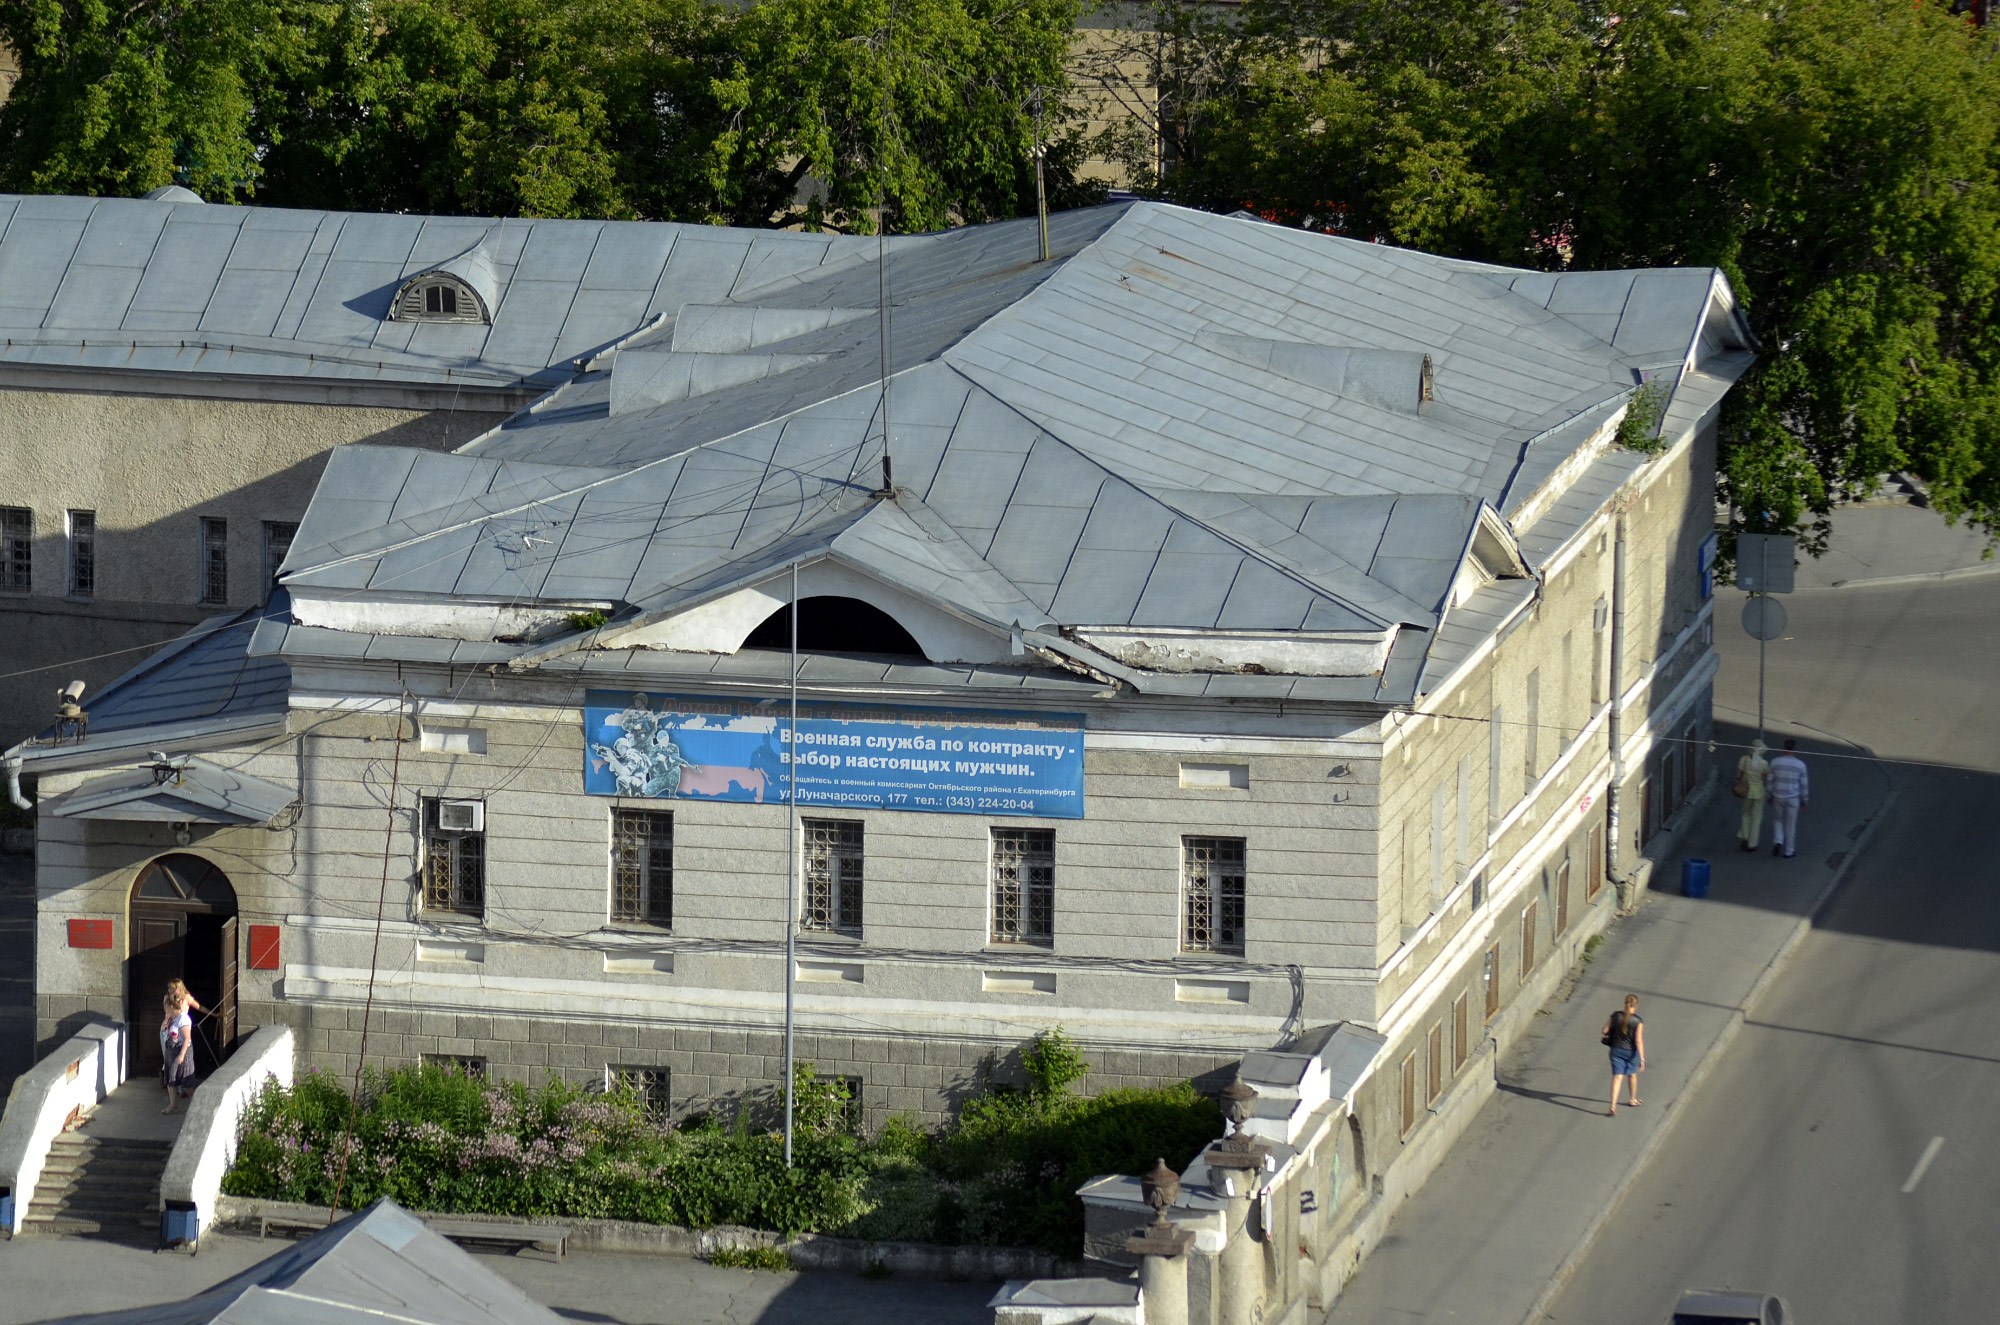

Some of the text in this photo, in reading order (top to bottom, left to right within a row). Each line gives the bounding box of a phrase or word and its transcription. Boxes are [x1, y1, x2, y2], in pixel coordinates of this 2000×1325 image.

[661, 697, 732, 717] Армия
[831, 710, 896, 726] армия
[780, 728, 862, 747] Военная
[866, 735, 936, 752] служба
[941, 740, 964, 752] по
[968, 741, 1066, 760] контракту
[780, 751, 1035, 777] выбор настоящих мужчин.
[779, 775, 832, 786] Обащайтесь
[841, 779, 875, 787] военный
[877, 780, 927, 790] комиссариат
[928, 783, 982, 793] Октябрьского
[984, 786, 1012, 794] района
[1013, 788, 1076, 798] г.Екатеринбурга
[888, 794, 908, 804] 177
[914, 796, 942, 806] тел.:
[946, 796, 975, 809] (343)
[978, 798, 1035, 810] 224-20-04
